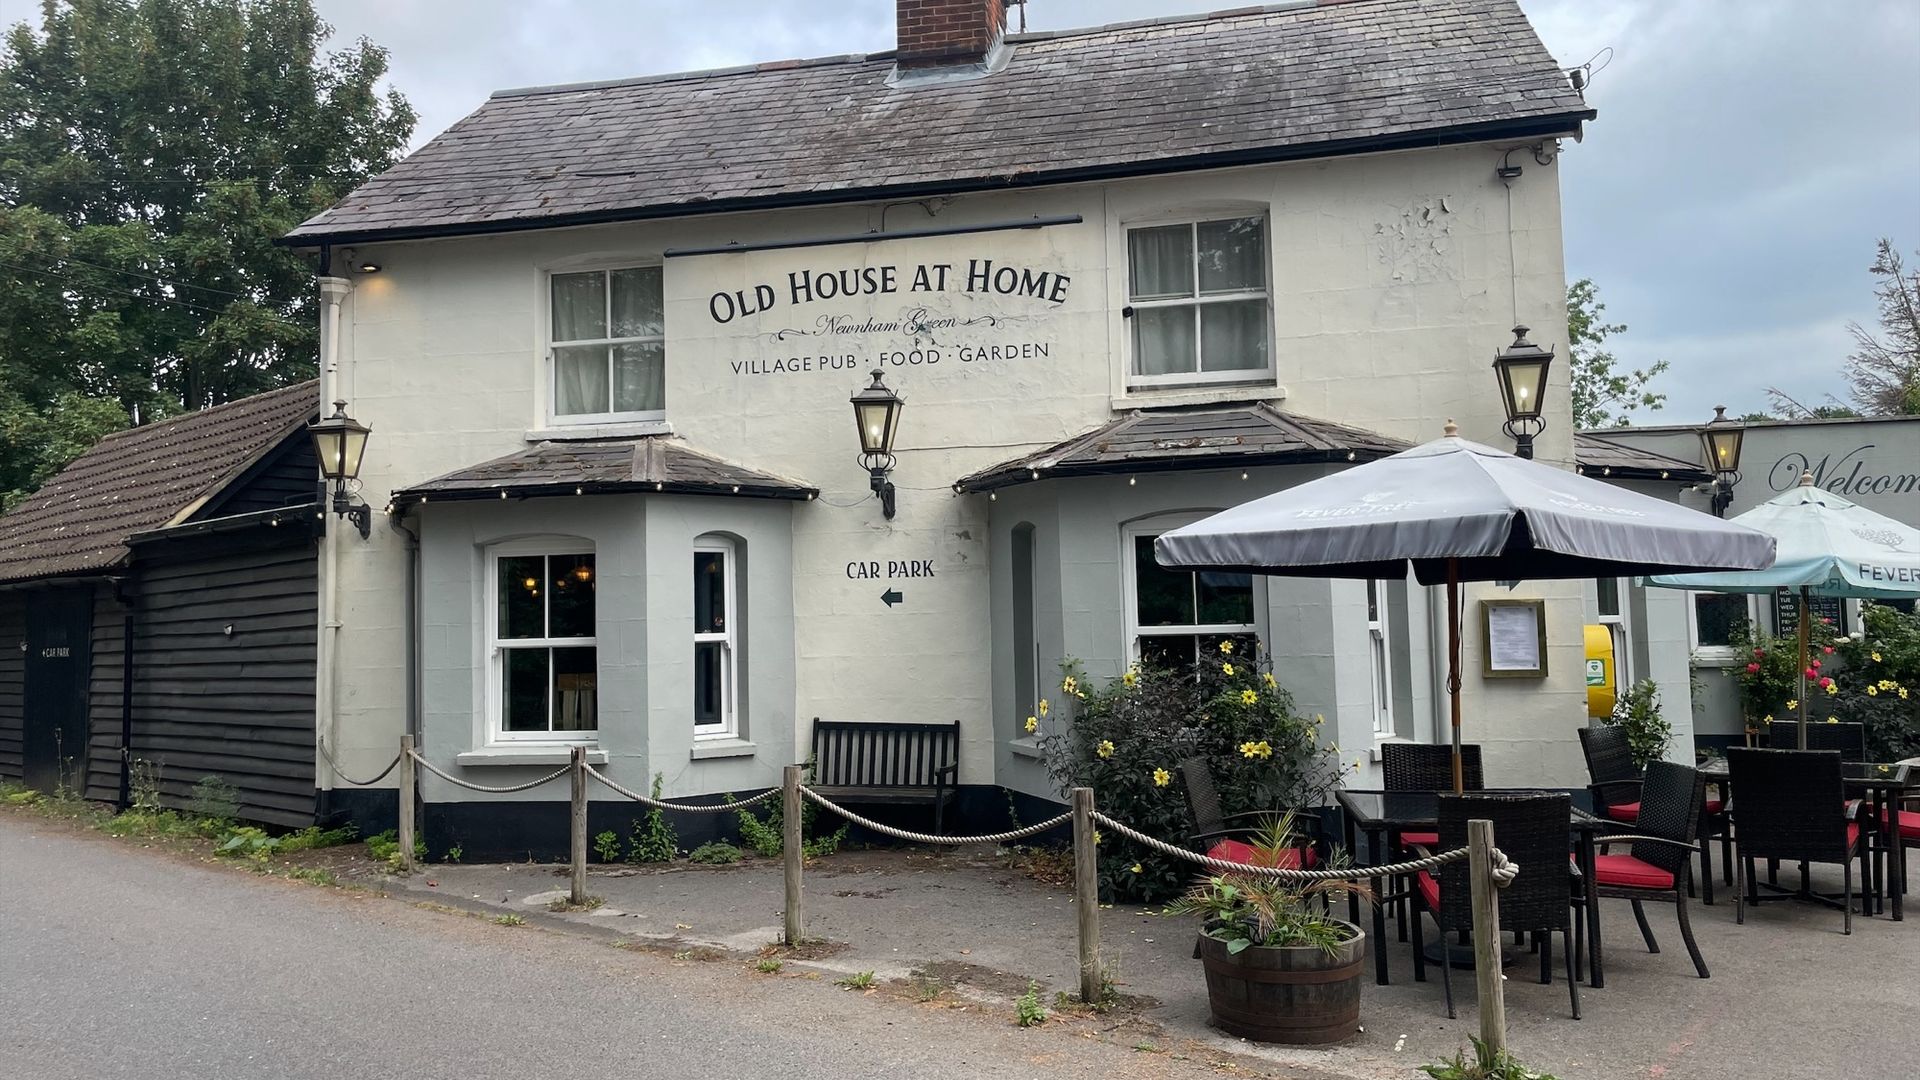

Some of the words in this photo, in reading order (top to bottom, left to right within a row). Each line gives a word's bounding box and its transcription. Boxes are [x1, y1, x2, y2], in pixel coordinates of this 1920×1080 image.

[709, 284, 776, 324] OLD
[788, 265, 898, 306] HOUSE
[910, 264, 952, 292] AT
[966, 259, 1071, 304] HOME
[731, 357, 812, 375] VILLAGE
[819, 354, 857, 371] PUB
[880, 350, 941, 367] FOOD
[959, 342, 1050, 363] GARDEN
[846, 561, 880, 579] CAR
[888, 559, 935, 578] PARK
[46, 647, 56, 658] CAR
